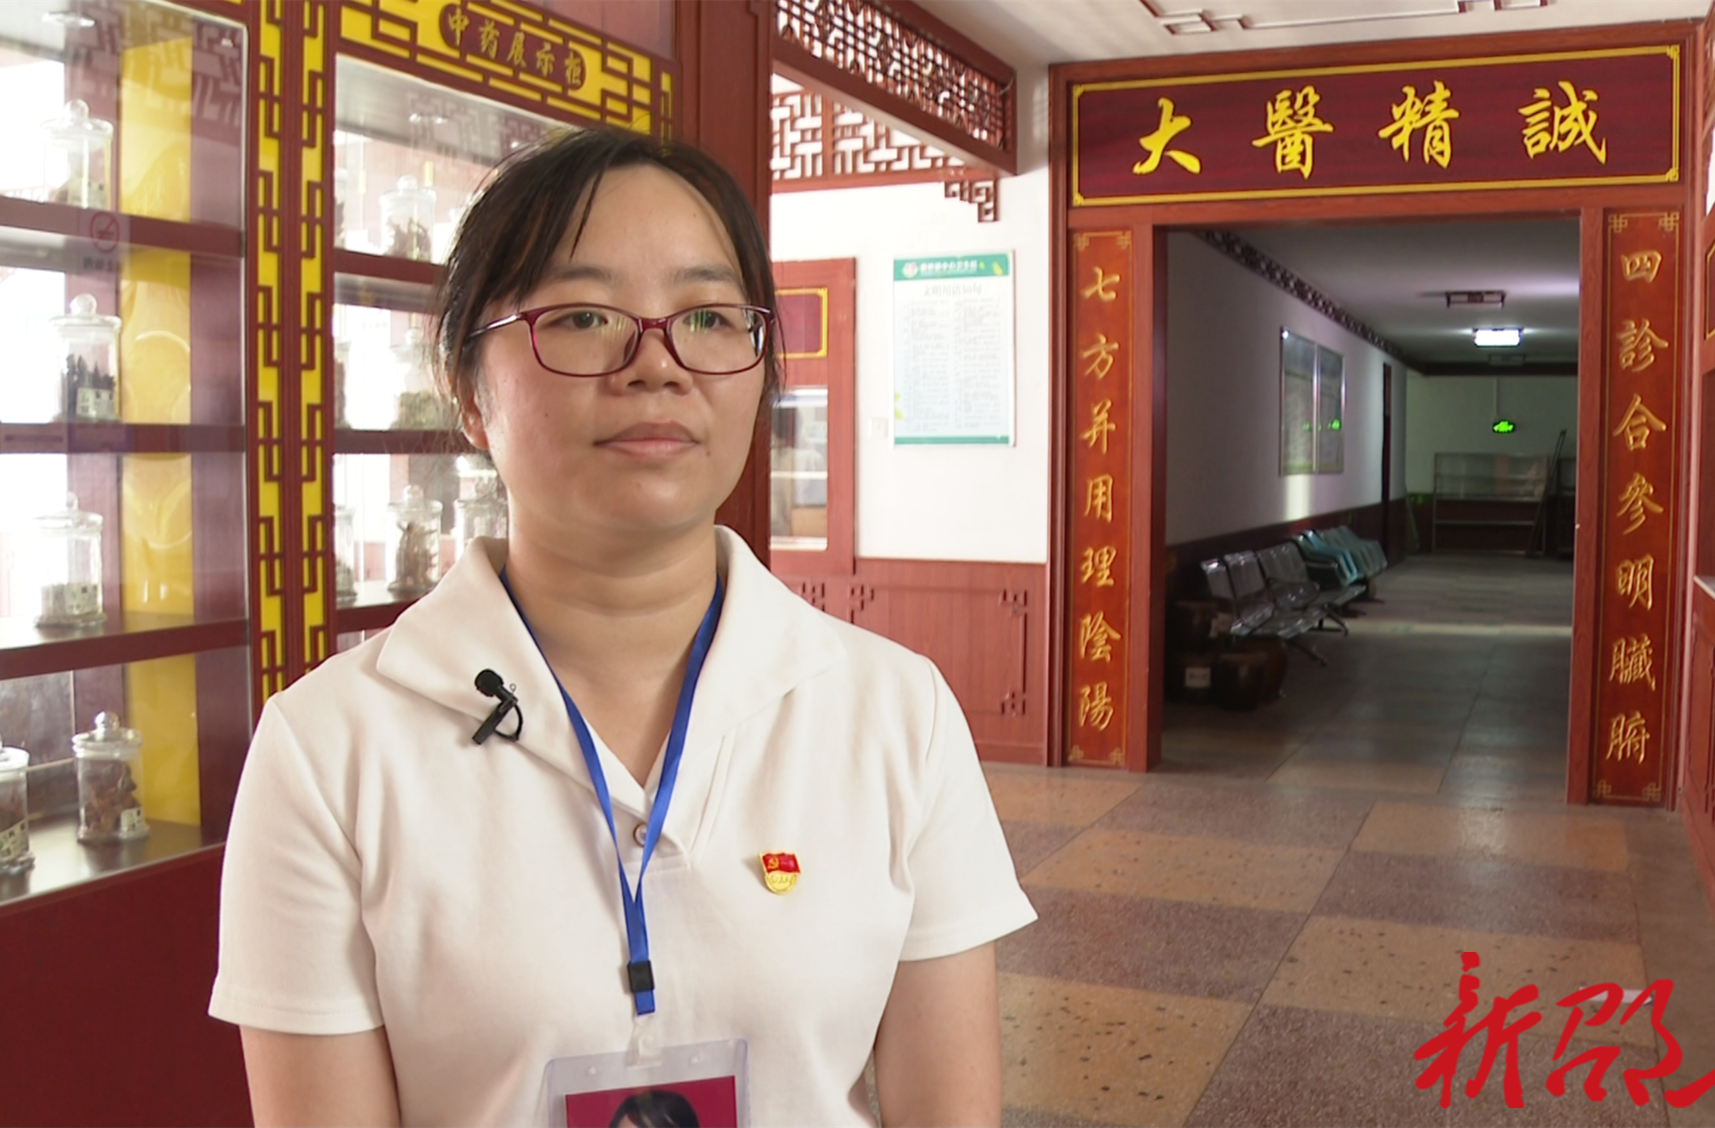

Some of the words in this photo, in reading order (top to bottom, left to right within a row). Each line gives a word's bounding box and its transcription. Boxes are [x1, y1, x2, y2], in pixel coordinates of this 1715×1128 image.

[447, 5, 583, 86] 中药展示柜
[1132, 80, 1608, 180] 大醫精誠
